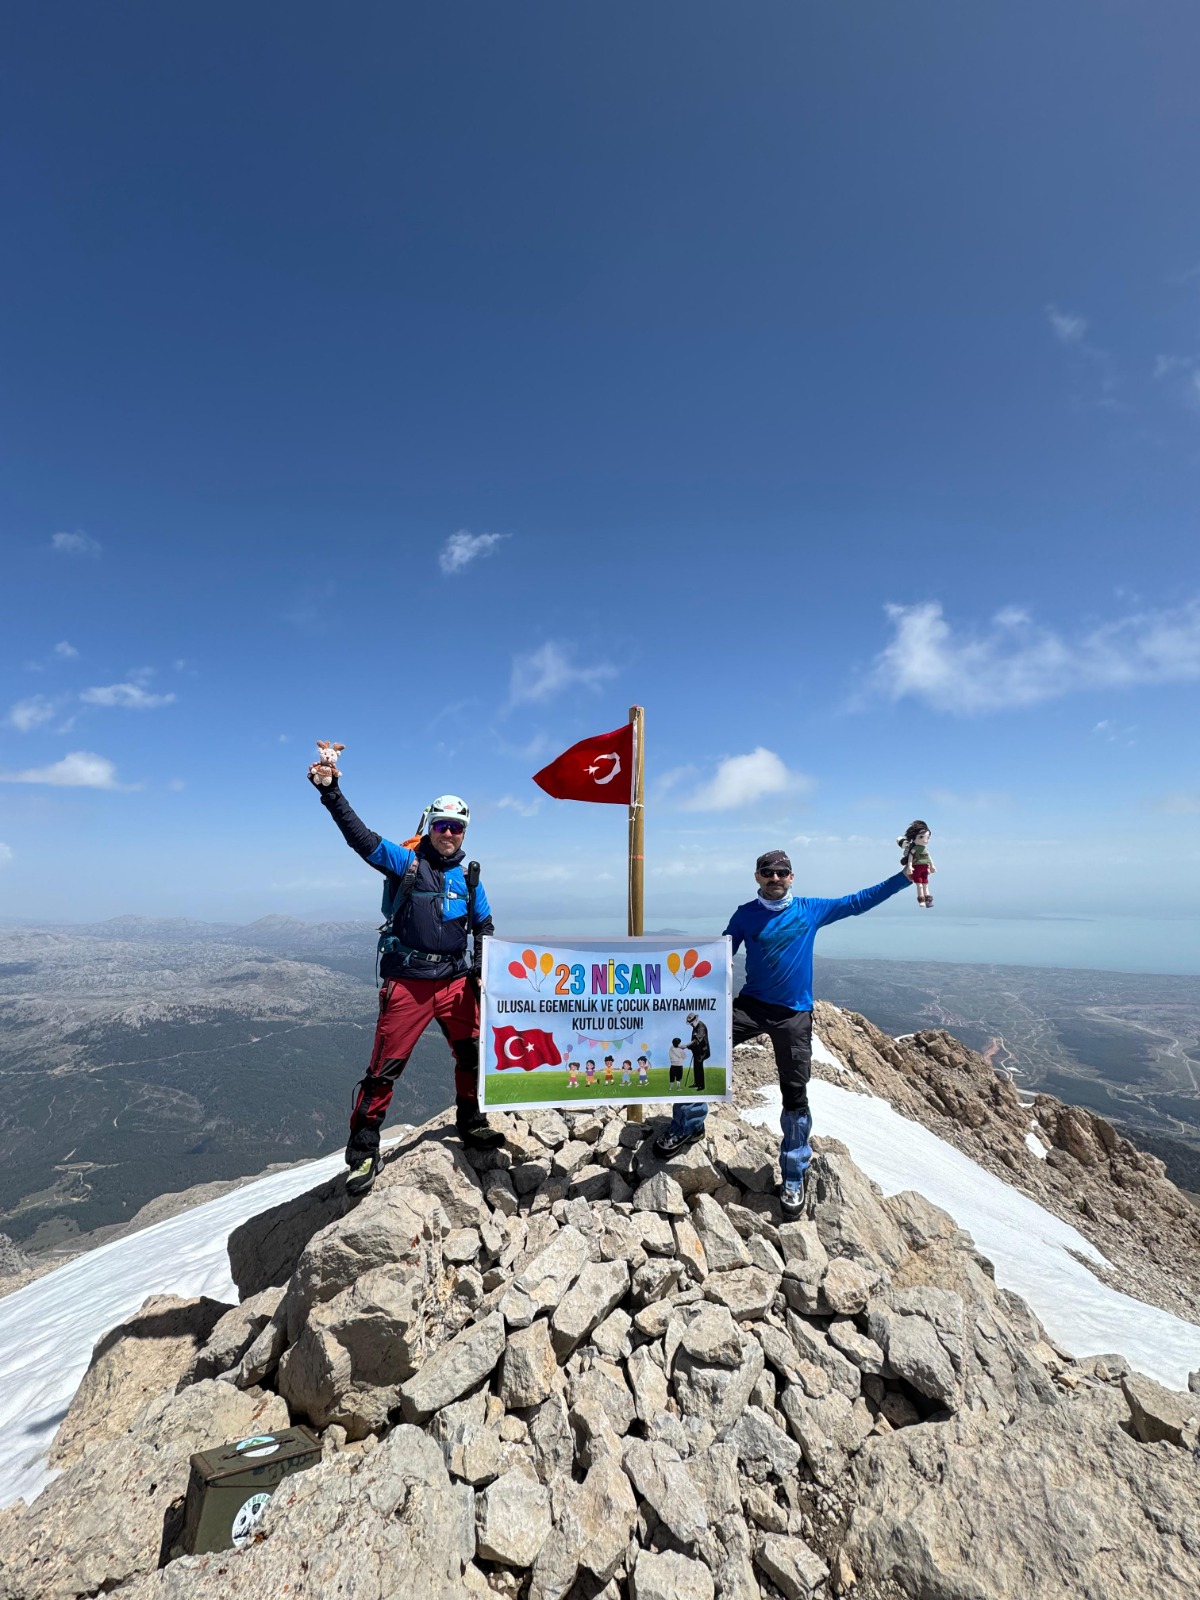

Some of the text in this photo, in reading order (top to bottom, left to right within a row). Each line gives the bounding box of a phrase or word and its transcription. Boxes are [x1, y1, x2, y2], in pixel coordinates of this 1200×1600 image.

[555, 958, 661, 995] 23 NİSAN
[497, 997, 717, 1014] ULUSAL EGEMENLİK VE ÇOCUK BAYRAMIMIZ
[572, 1016, 644, 1030] KUTLU OLSUN!
